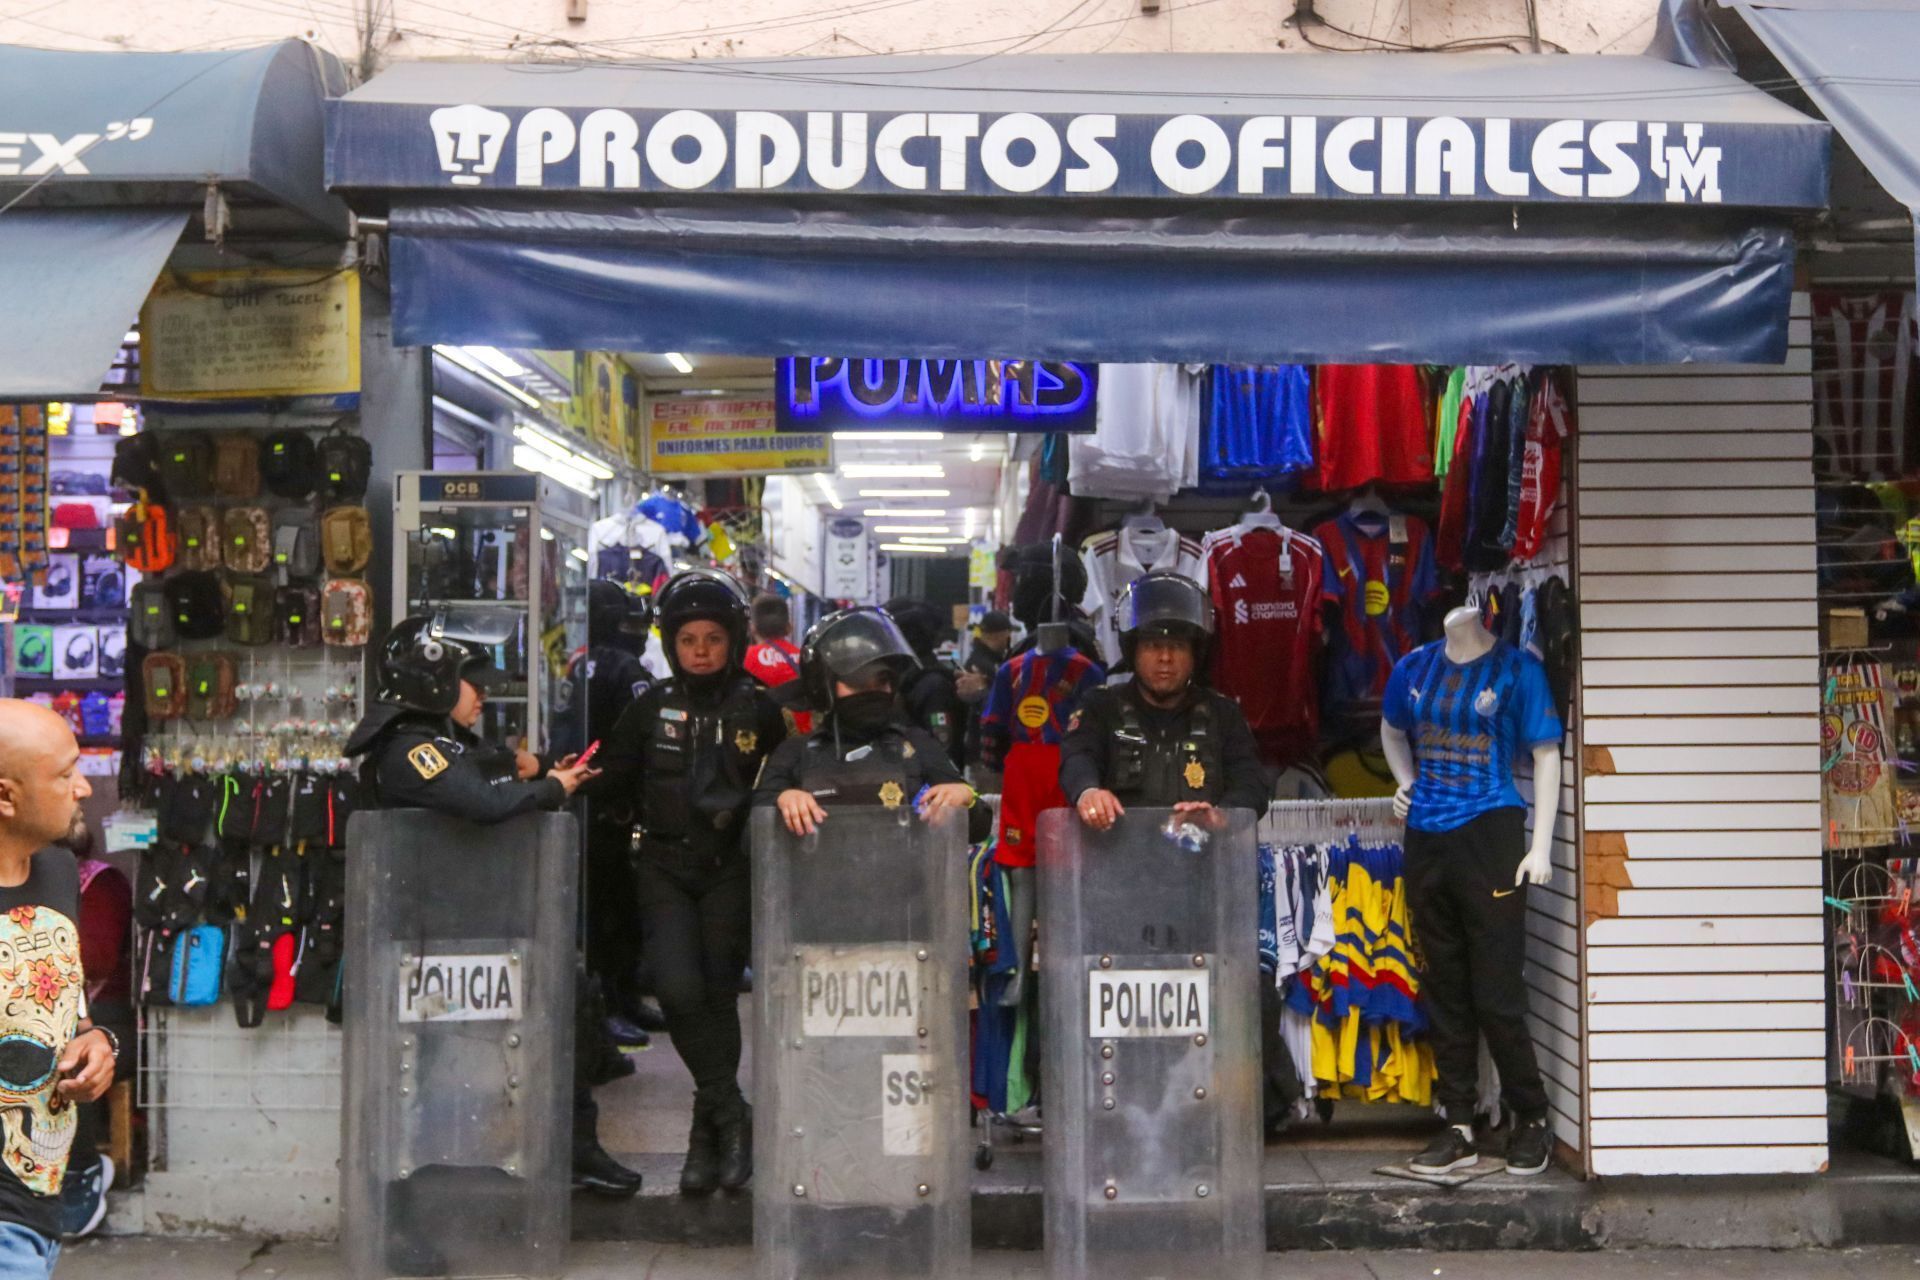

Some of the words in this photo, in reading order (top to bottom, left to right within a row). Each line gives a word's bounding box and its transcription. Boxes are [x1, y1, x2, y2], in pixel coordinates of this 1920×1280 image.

[515, 107, 1118, 193] PRODUCTOS
[1150, 114, 1640, 198] OFICIALES
[789, 356, 1090, 408] PUMAS
[653, 400, 775, 420] ESTAMPA
[656, 436, 731, 456] UNIFORMES
[733, 436, 767, 453] PARA
[767, 434, 825, 451] EQUIPOS
[444, 481, 479, 495] OCB
[1251, 601, 1295, 611] standard
[1251, 609, 1298, 620] chartered
[407, 965, 513, 1011] POLICIA
[807, 970, 913, 1017] POLICIA
[1099, 982, 1202, 1029] POLICIA
